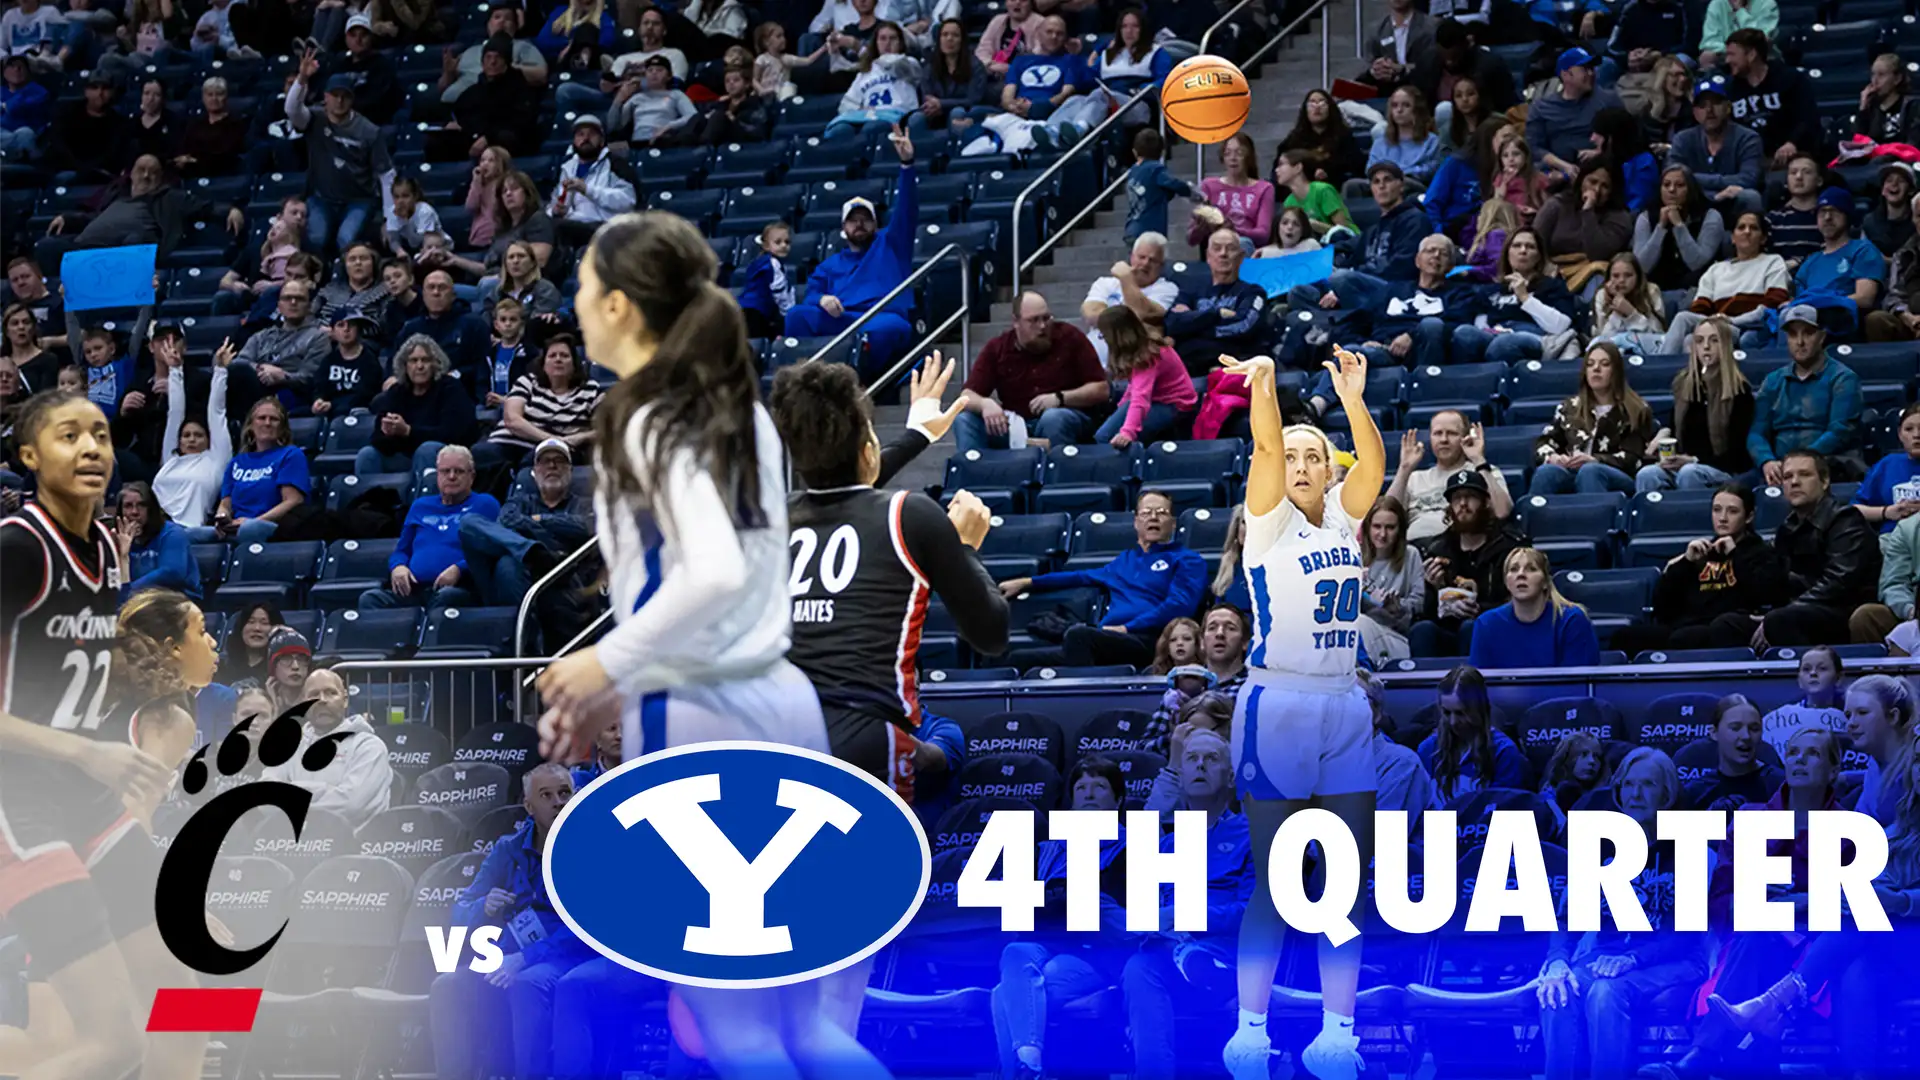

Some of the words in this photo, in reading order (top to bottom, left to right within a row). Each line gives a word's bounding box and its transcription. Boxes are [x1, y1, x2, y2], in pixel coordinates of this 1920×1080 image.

[1731, 92, 1781, 118] BYU
[1458, 471, 1468, 485] S
[787, 524, 860, 597] 20
[1298, 547, 1361, 575] BRIGHA
[1314, 577, 1360, 624] 30
[793, 599, 834, 623] HAYES
[1640, 723, 1716, 739] SAPPHIR
[968, 737, 1049, 752] SAPPHIRE
[1077, 736, 1143, 751] SAPPHI
[388, 752, 431, 765] PHIRE
[453, 748, 528, 762] SAPPHIRE
[418, 783, 498, 806] SAPPHIRE
[960, 781, 1046, 798] SAPPHIRE
[253, 838, 334, 853] SAPPHIRE
[360, 838, 444, 856] SAPPHIRE
[346, 870, 361, 883] 47
[207, 889, 273, 905] PPHIRE
[301, 889, 390, 907] SAPPHIRE
